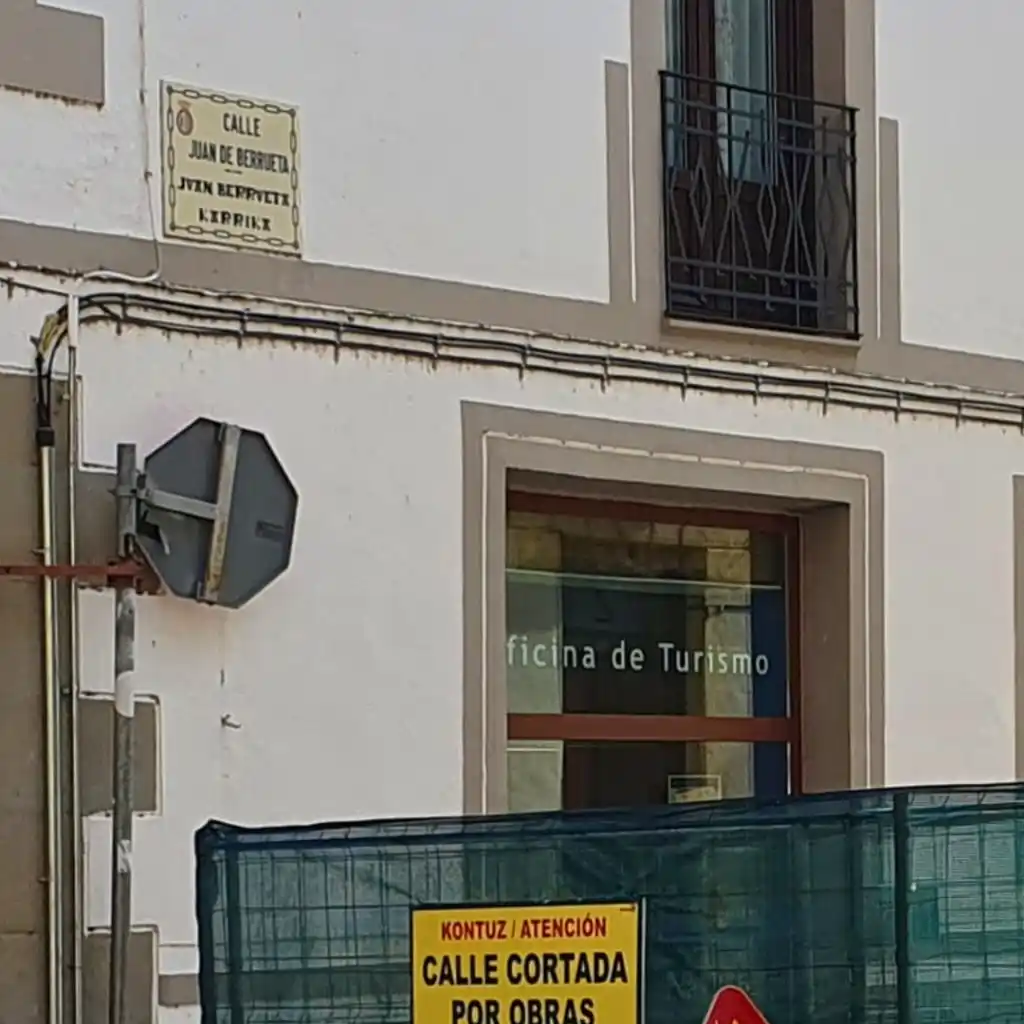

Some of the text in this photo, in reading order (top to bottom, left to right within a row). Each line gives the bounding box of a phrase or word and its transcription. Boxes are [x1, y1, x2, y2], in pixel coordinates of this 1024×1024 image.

[223, 112, 262, 138] CALLE
[188, 139, 290, 174] JUAN DE BERRUETA
[507, 634, 769, 676] ficina de Turismo
[441, 920, 507, 941] KONTUZ
[520, 912, 607, 939] ATENCIÓN
[422, 951, 629, 986] CALLE CORTADA
